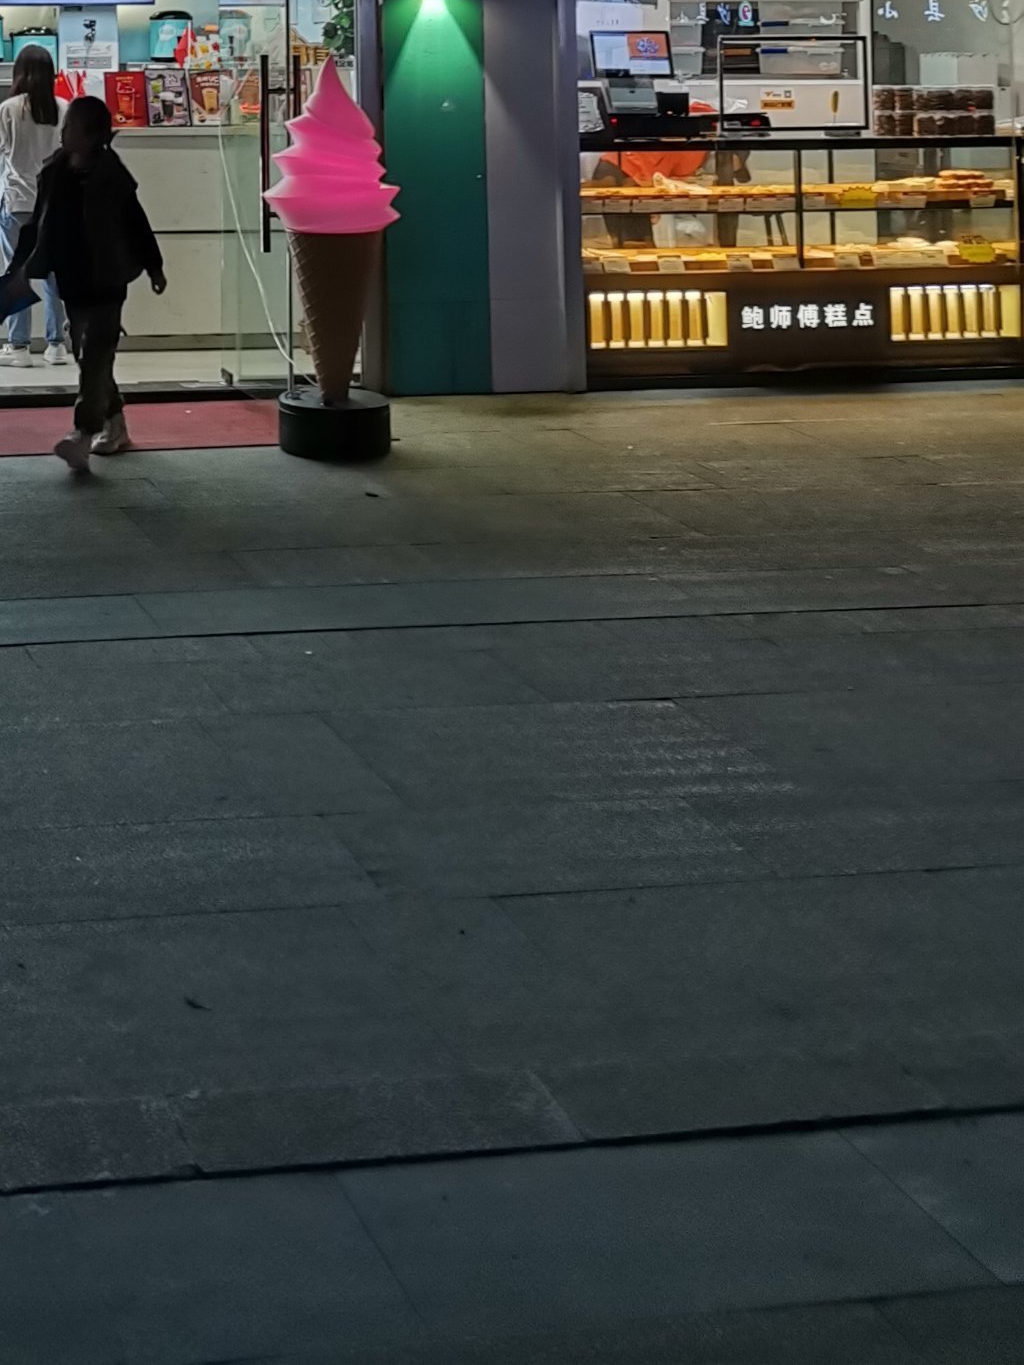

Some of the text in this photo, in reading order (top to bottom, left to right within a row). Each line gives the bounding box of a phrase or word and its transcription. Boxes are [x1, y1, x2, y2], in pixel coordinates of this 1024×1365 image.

[741, 302, 875, 331] 鲍师傅糕点
